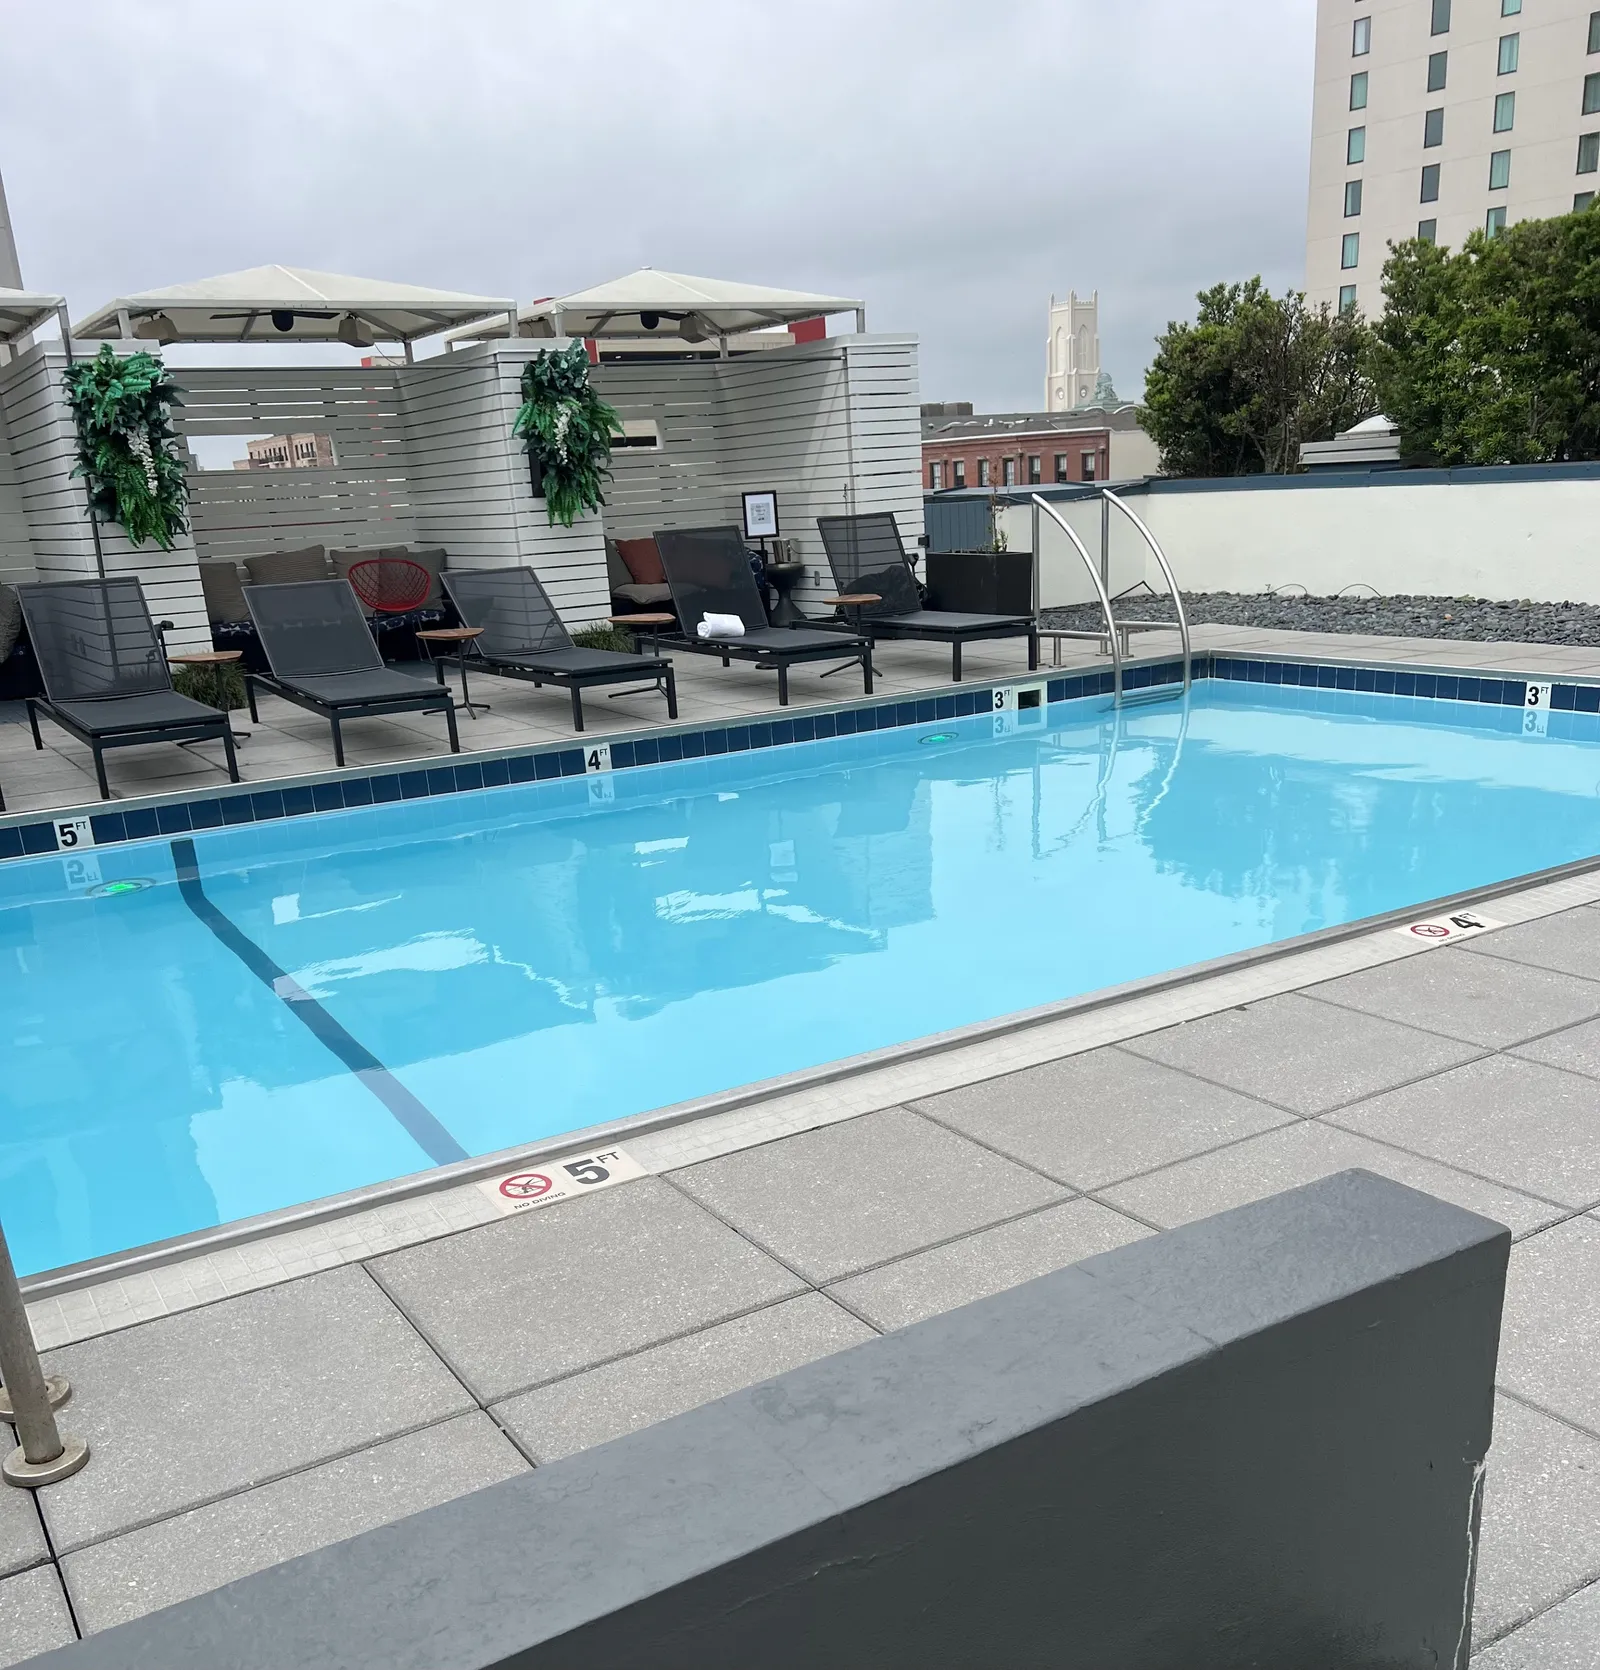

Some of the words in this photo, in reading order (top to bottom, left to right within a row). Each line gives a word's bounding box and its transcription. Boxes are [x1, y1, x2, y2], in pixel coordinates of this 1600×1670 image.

[994, 691, 1004, 709] 3
[1004, 689, 1011, 697] FT
[1527, 686, 1540, 706] 3
[1540, 686, 1550, 694] FT
[588, 750, 601, 770] 4
[600, 748, 608, 756] FT
[58, 823, 78, 847] 5
[75, 820, 87, 831] FT
[1449, 916, 1486, 929] 4
[562, 1158, 610, 1185] 5
[596, 1151, 621, 1164] FT
[513, 1202, 530, 1210] NO
[532, 1191, 567, 1205] DIVING
